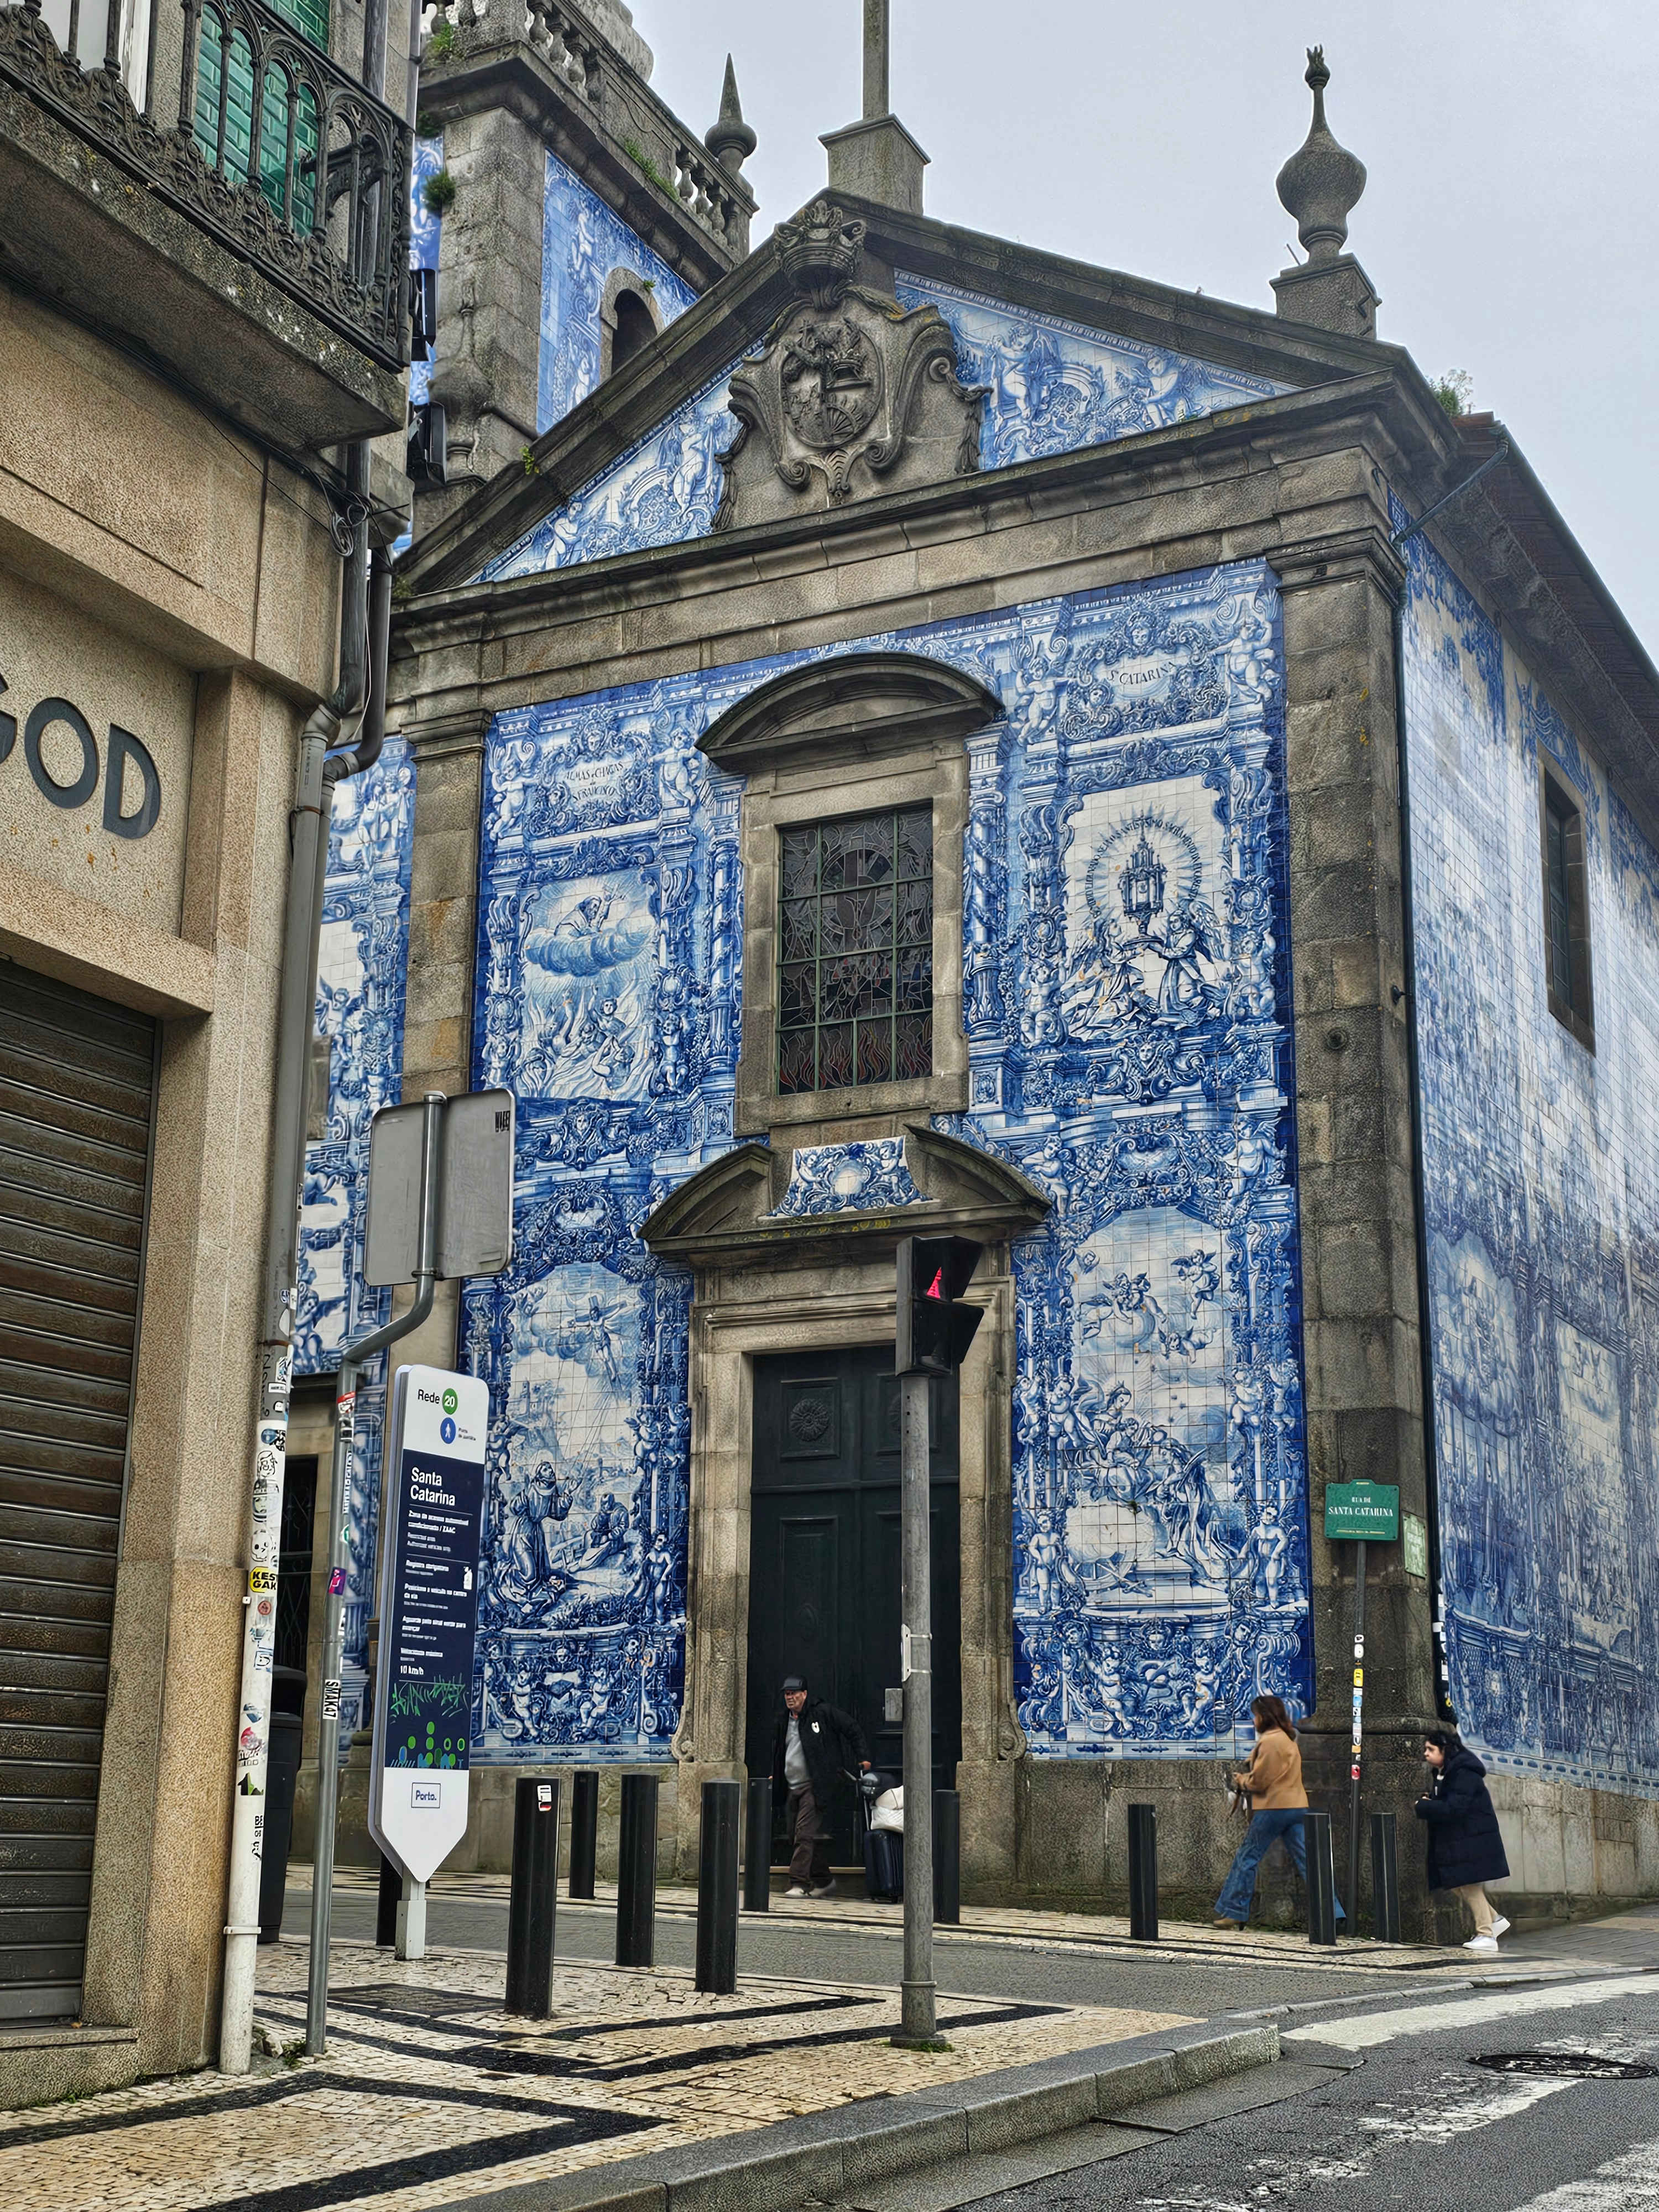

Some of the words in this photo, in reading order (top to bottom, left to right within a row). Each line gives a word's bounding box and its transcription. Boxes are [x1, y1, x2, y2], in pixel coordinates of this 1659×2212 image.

[418, 1389, 440, 1404] Rede
[444, 1395, 455, 1407] 20
[411, 1467, 442, 1486] Santa
[410, 1485, 455, 1506] Catarina
[1328, 1506, 1353, 1515] SANTA
[1355, 1507, 1393, 1516] CATARINA
[400, 1665, 408, 1674] 10
[416, 1790, 437, 1801] Porto.
